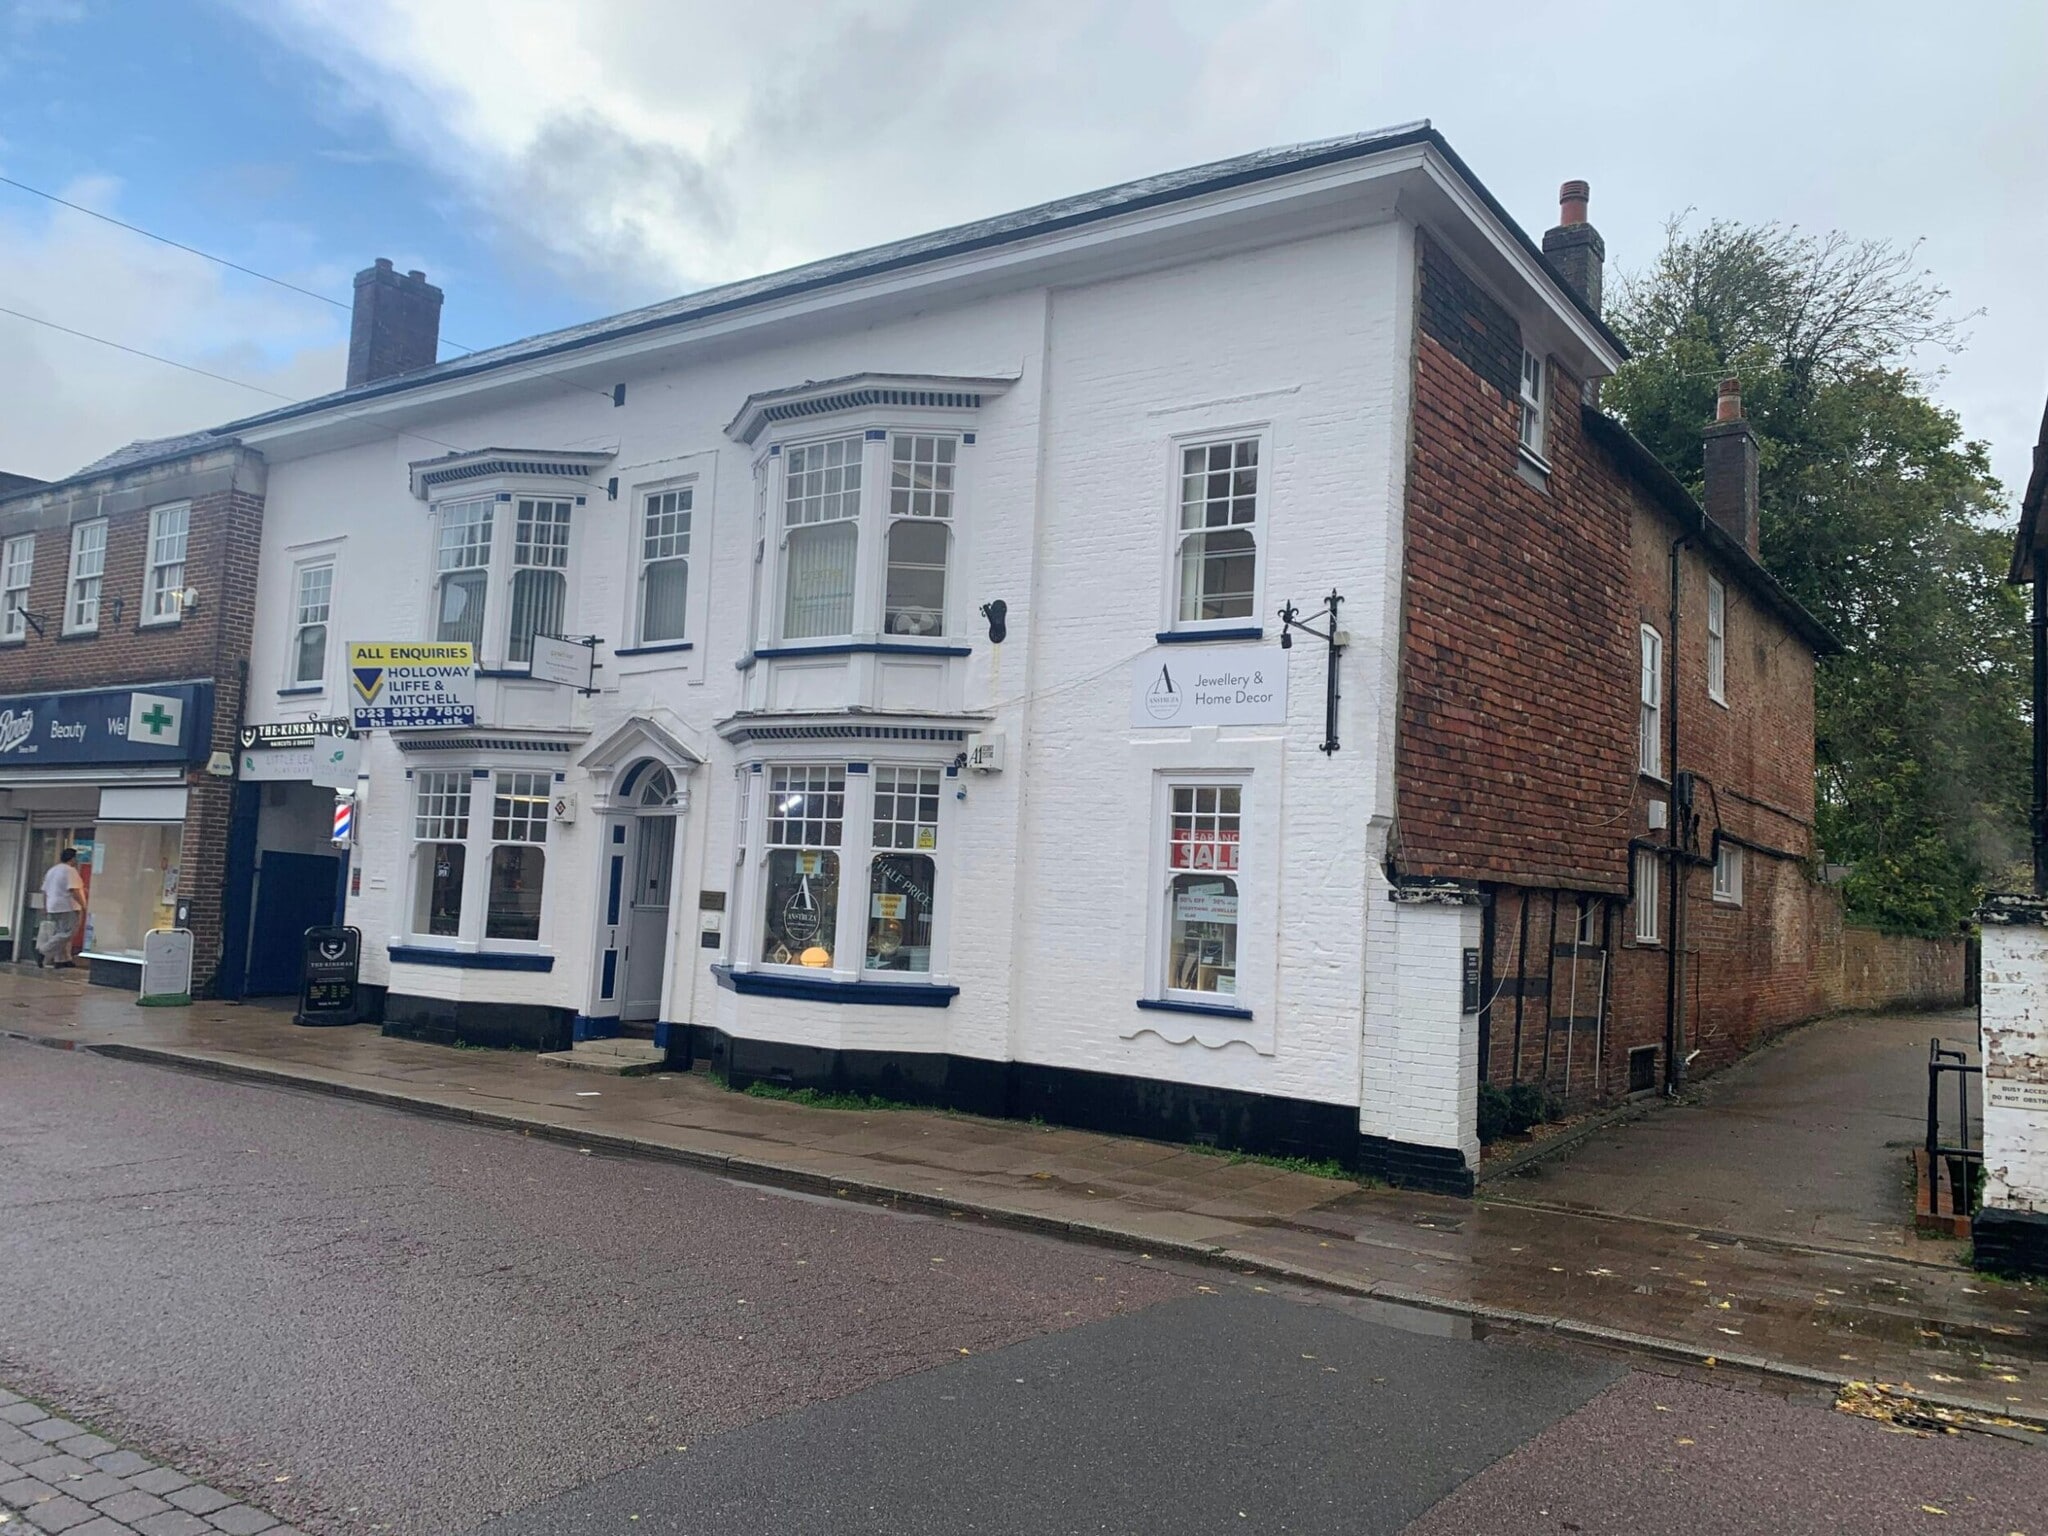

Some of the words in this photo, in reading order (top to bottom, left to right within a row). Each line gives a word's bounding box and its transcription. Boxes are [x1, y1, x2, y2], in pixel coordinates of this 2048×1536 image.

[356, 648, 384, 659] ALL
[390, 647, 468, 660] ENQUIRIES
[388, 666, 471, 678] HOLLOWAY
[388, 680, 431, 692] ILIFFE
[434, 680, 445, 691] &
[1194, 673, 1250, 689] Jewellery
[1253, 670, 1264, 684] &
[389, 693, 461, 706] MITCHELL
[1195, 692, 1232, 705] Home
[1235, 690, 1273, 704] Decor
[356, 708, 385, 718] 023
[392, 707, 429, 718] 9237
[435, 705, 473, 717] 7800
[369, 716, 465, 727] hi-m.co.uk
[50, 720, 87, 743] Beauty
[258, 725, 278, 737] THE
[280, 723, 329, 736] KINSMAN
[877, 861, 905, 883] HALF
[901, 880, 933, 907] PRICE
